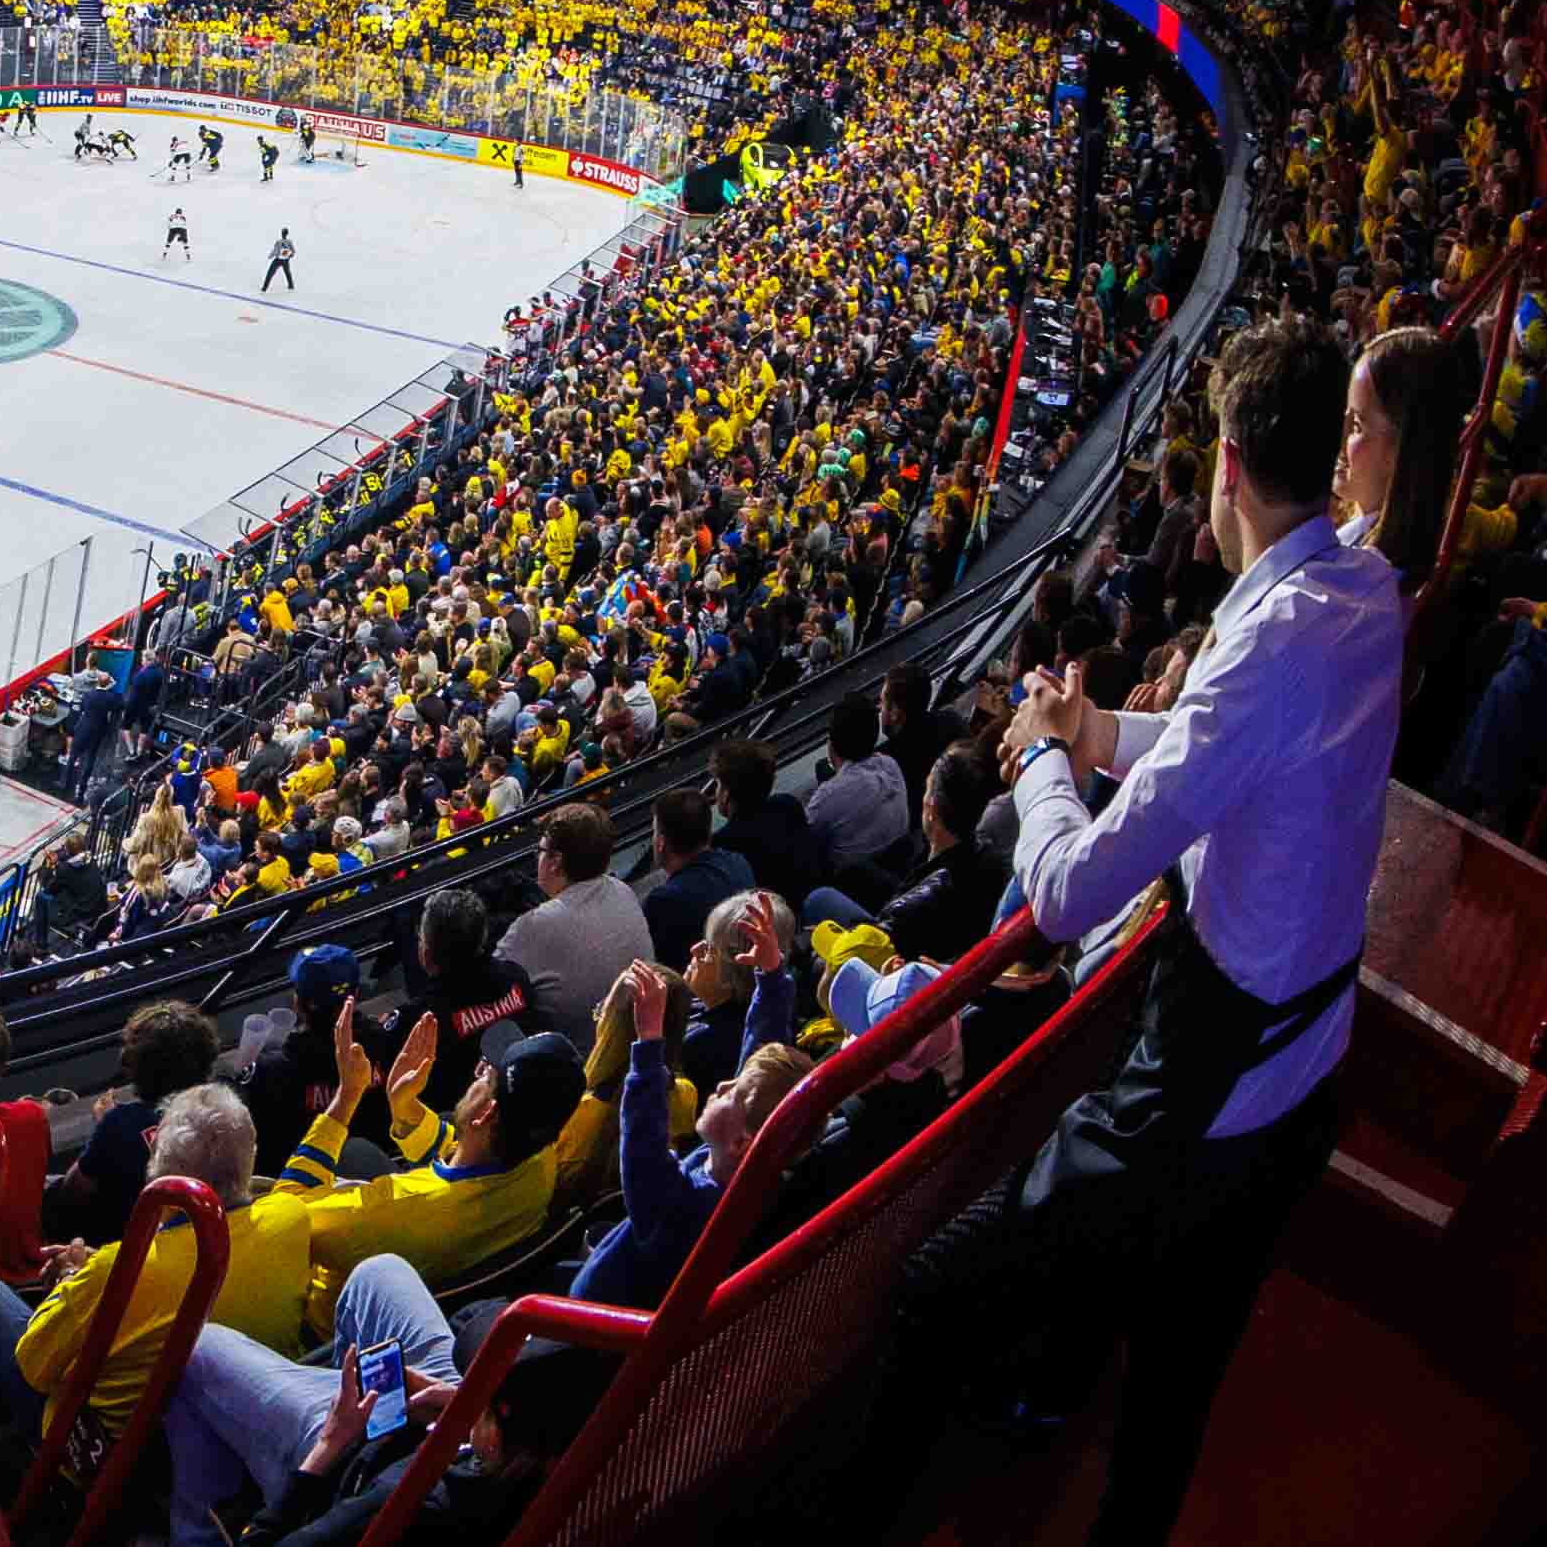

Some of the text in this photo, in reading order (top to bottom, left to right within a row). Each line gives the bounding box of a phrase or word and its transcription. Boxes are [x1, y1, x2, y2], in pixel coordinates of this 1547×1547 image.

[97, 92, 122, 103] LIVE
[235, 102, 273, 117] TISSOT
[584, 162, 638, 192] STRAUSS
[460, 987, 523, 1033] AUSTRIA
